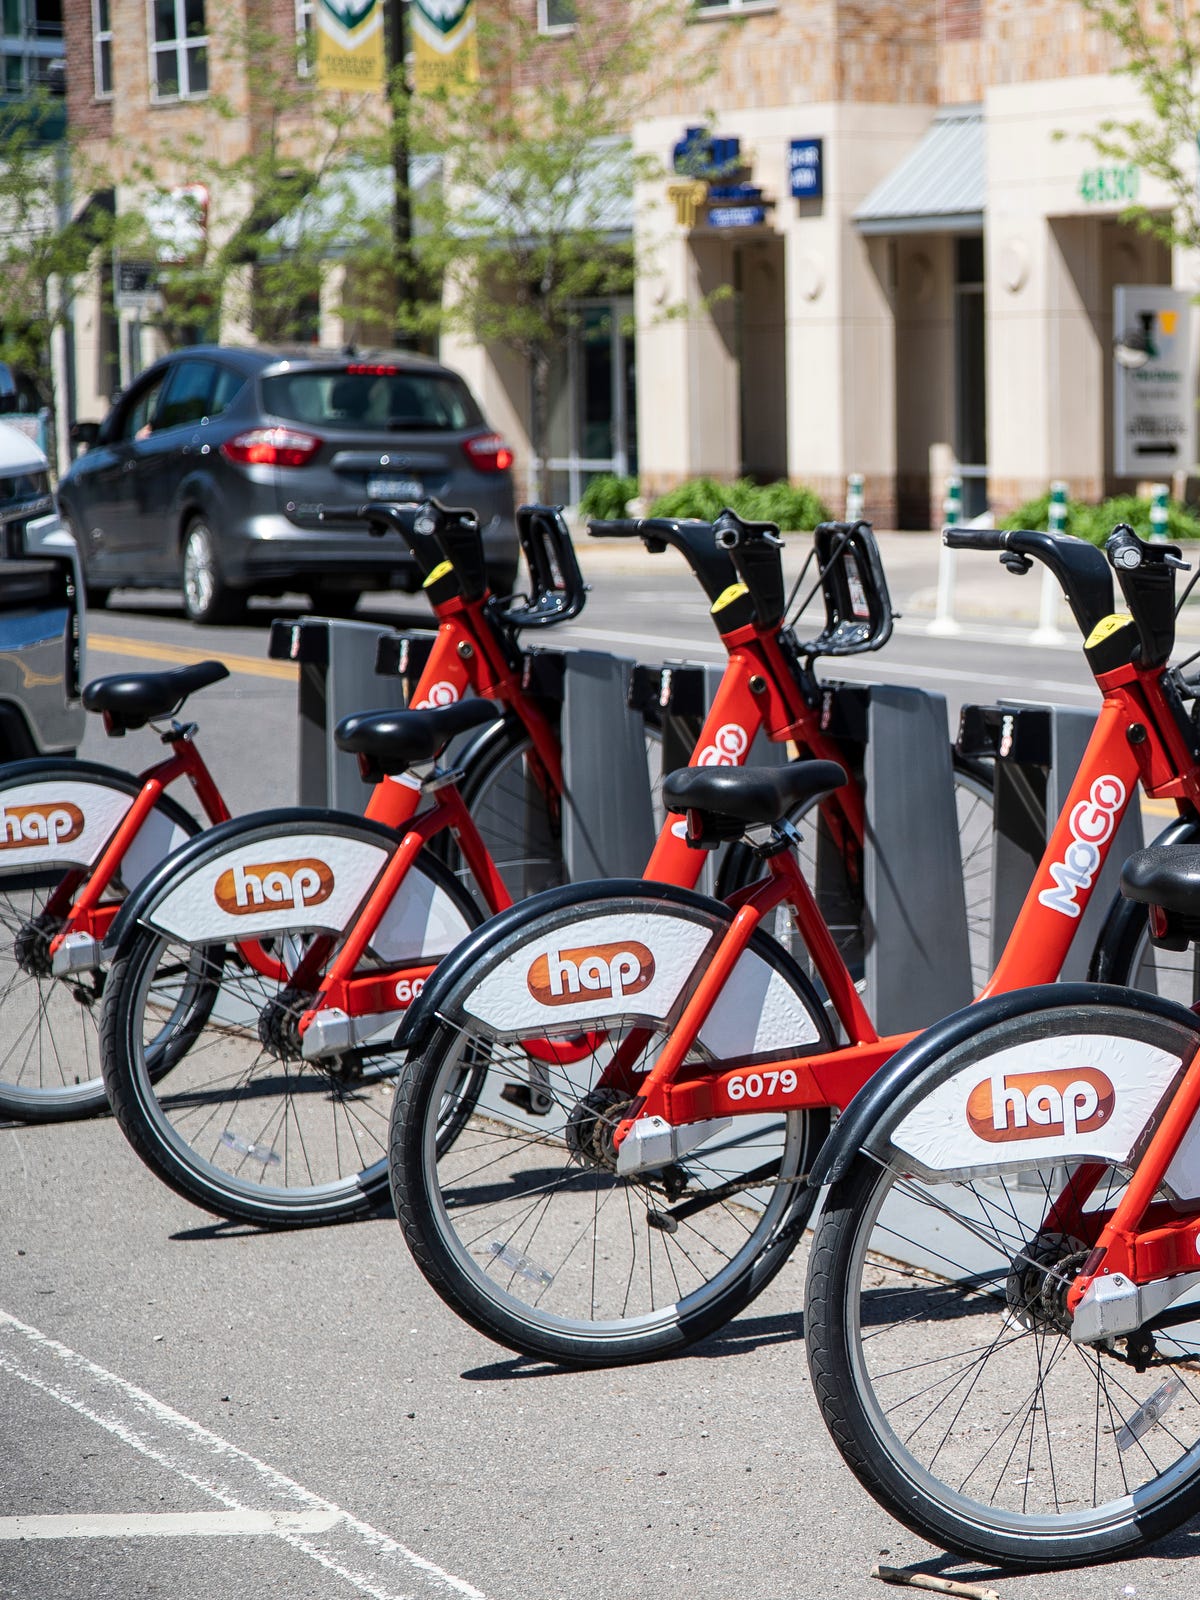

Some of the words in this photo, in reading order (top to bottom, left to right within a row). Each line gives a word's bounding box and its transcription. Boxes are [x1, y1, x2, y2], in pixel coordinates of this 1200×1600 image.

[0, 807, 73, 847] hap
[1038, 774, 1126, 918] MoGo
[232, 866, 321, 909] hap
[395, 978, 425, 1002] 60
[547, 951, 641, 998] hap
[727, 1069, 798, 1100] 6079
[990, 1075, 1098, 1135] hap
